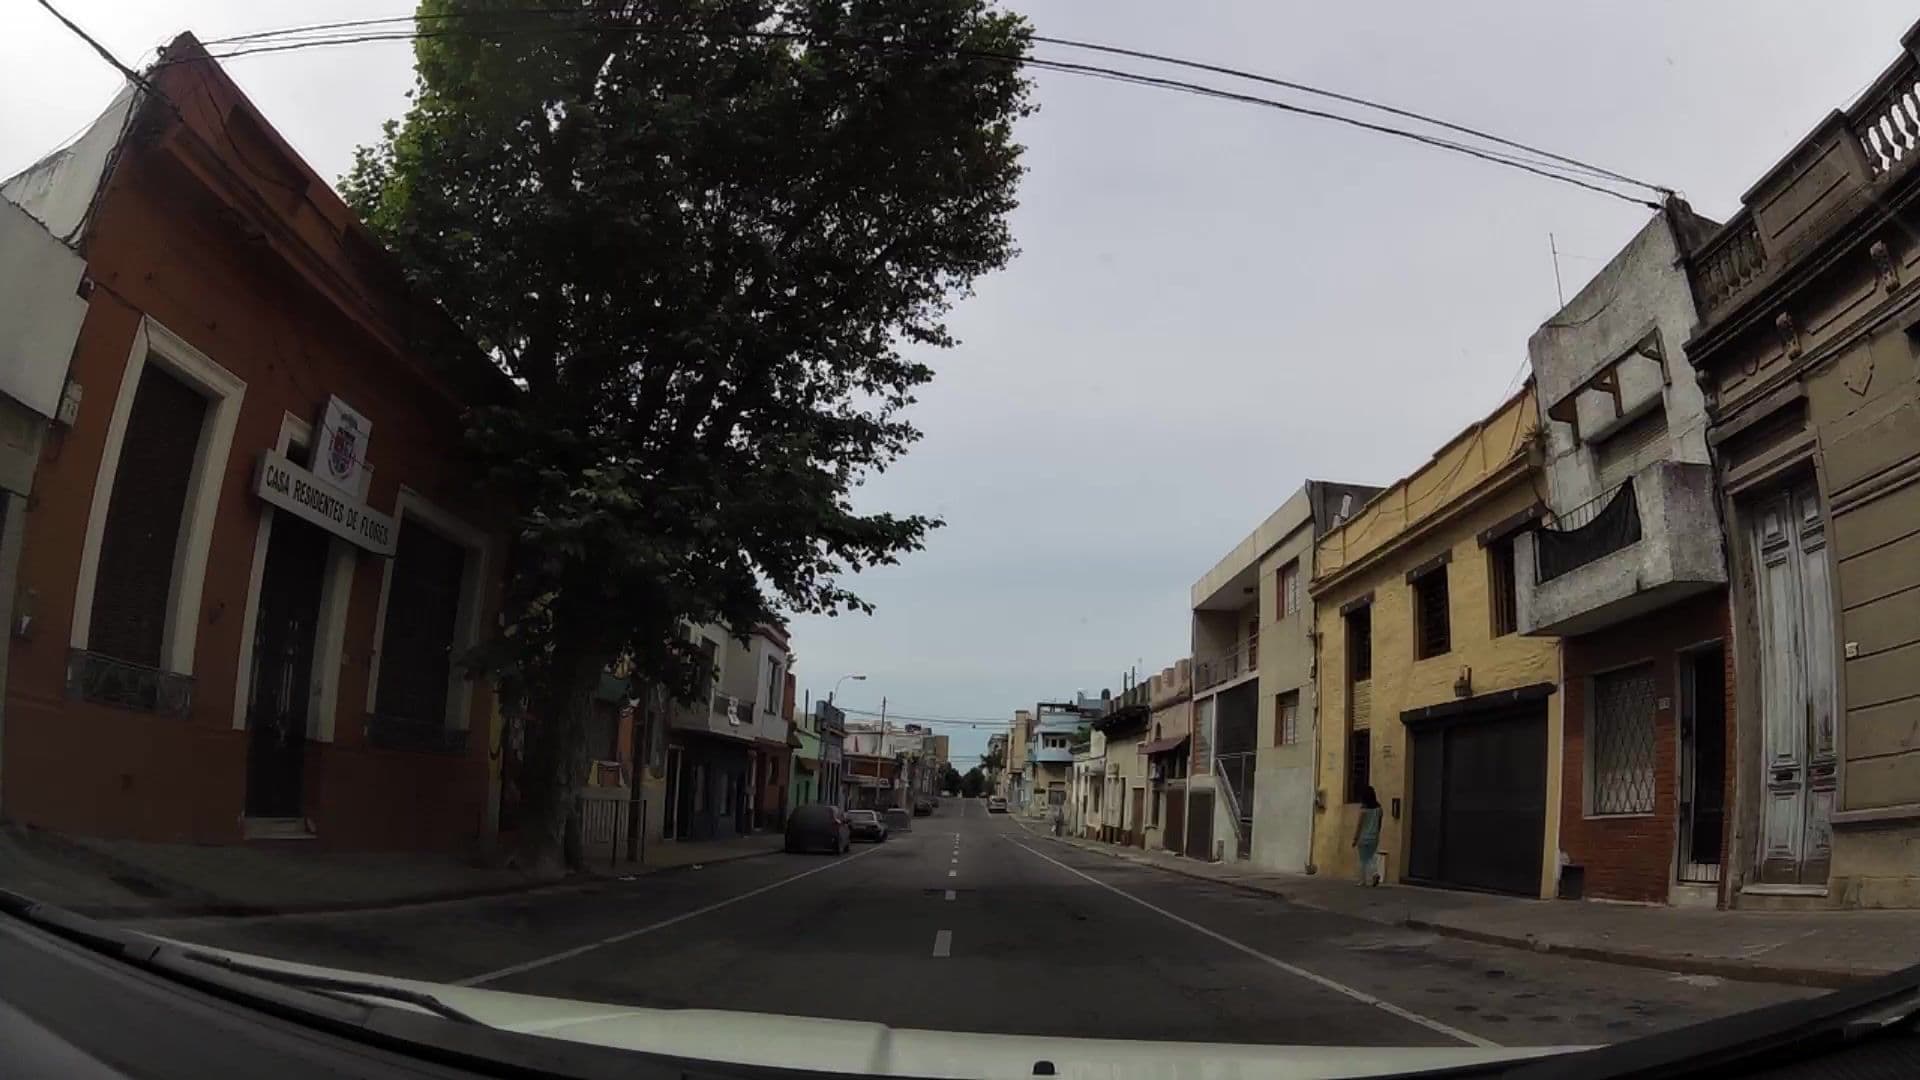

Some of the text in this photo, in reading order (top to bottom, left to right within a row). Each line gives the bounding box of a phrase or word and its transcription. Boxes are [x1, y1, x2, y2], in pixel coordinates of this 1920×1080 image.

[266, 465, 389, 546] CASA RESIDENTES DE FLORES
